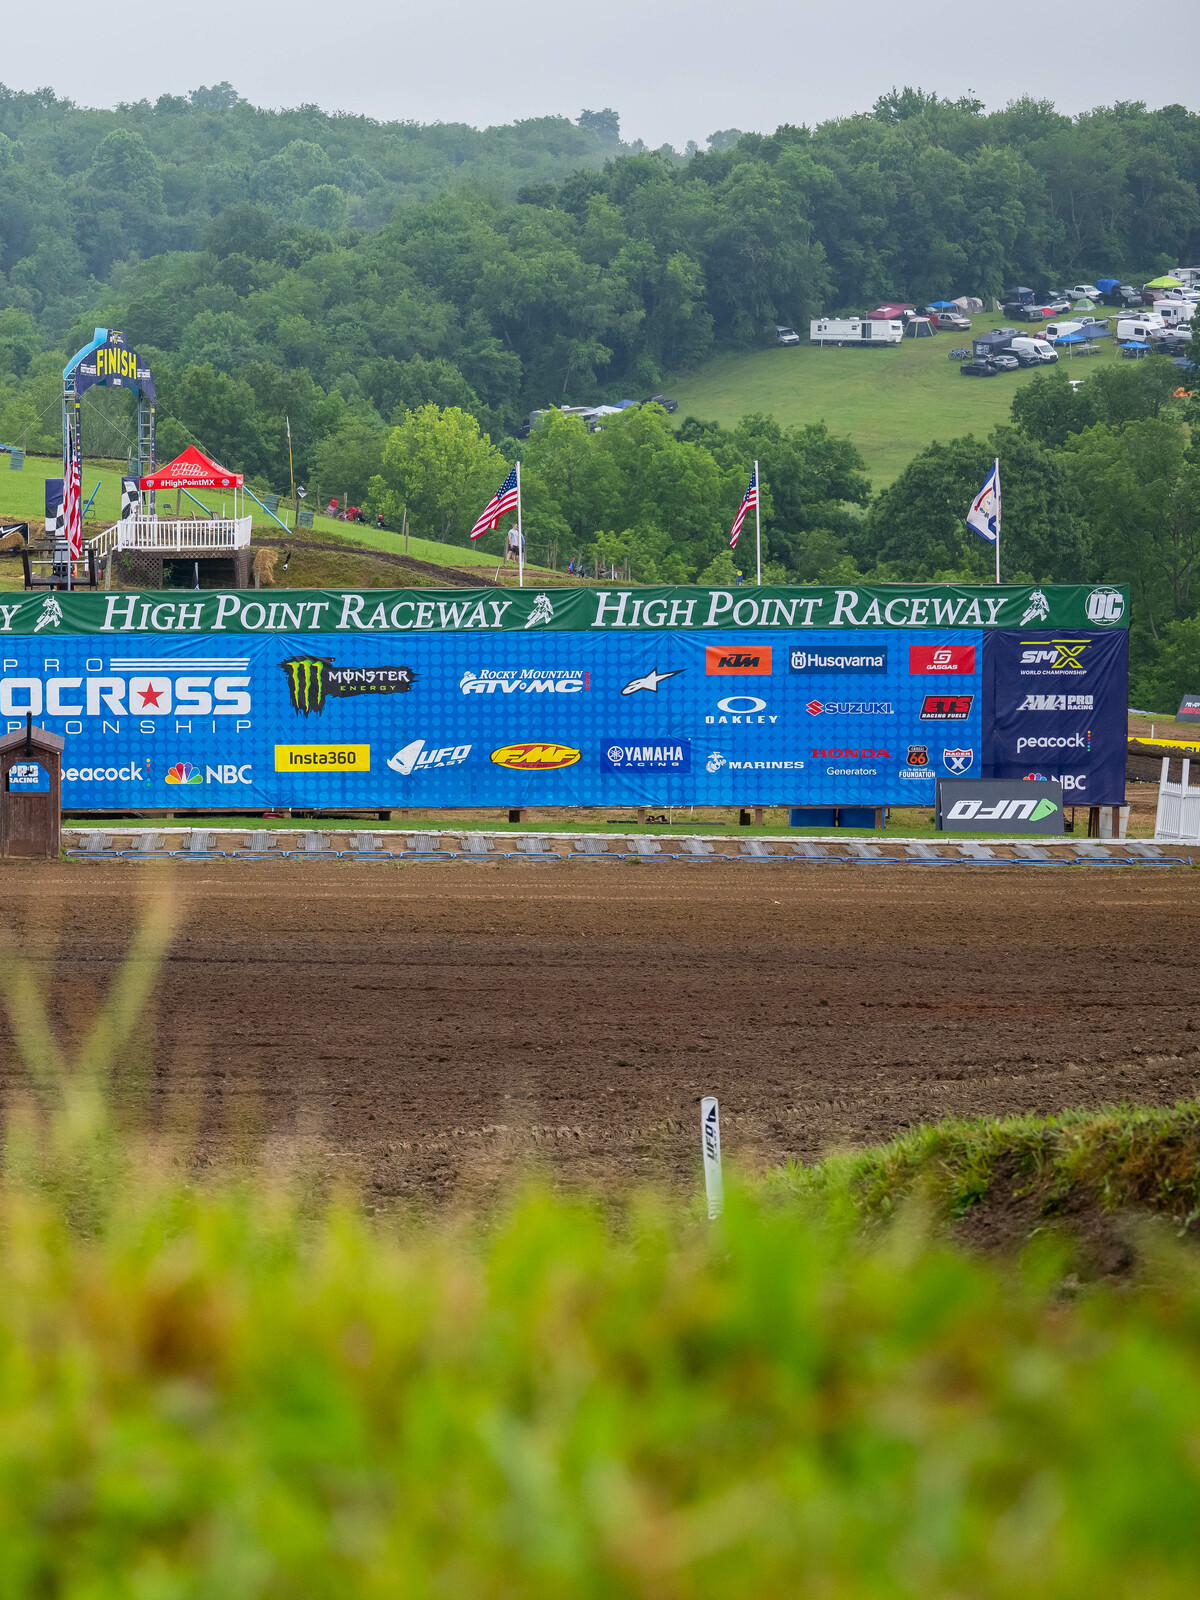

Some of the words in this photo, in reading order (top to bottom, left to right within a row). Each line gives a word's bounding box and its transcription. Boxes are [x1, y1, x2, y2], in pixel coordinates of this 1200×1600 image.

[97, 347, 136, 379] FINISH
[161, 479, 215, 488] #HighPointMX
[100, 595, 205, 630] HIGH
[211, 594, 329, 630] POINT
[336, 594, 512, 629] RACEWAY
[590, 592, 698, 627] HIGH
[703, 591, 822, 626] POINT
[829, 590, 1008, 626] RACEWAY
[717, 654, 760, 668] KTM
[808, 653, 883, 669] Husqvarna
[1020, 645, 1086, 669] SMX
[3, 658, 103, 673] PRO
[328, 669, 410, 683] MONSTER
[479, 669, 518, 679] ROCKY
[519, 669, 583, 679] MOUNTAIN
[825, 702, 892, 714] SUZUKI
[924, 697, 971, 713] ETS
[1016, 695, 1066, 711] AMA
[1067, 695, 1094, 705] PRO
[705, 715, 778, 724] OAKLEY
[1016, 732, 1085, 753] peacock
[289, 751, 356, 765] Insta360
[416, 744, 472, 765] UFO
[492, 746, 580, 763] FMF
[624, 746, 684, 761] YAMAHA
[811, 748, 892, 759] HONDA
[909, 752, 926, 764] 66
[414, 759, 466, 771] PLAST
[728, 761, 805, 769] MARINES
[951, 757, 965, 769] X
[206, 764, 252, 784] NBC
[826, 767, 877, 776] Generators
[946, 800, 1038, 819] UFO
[705, 1124, 716, 1161] UFO
